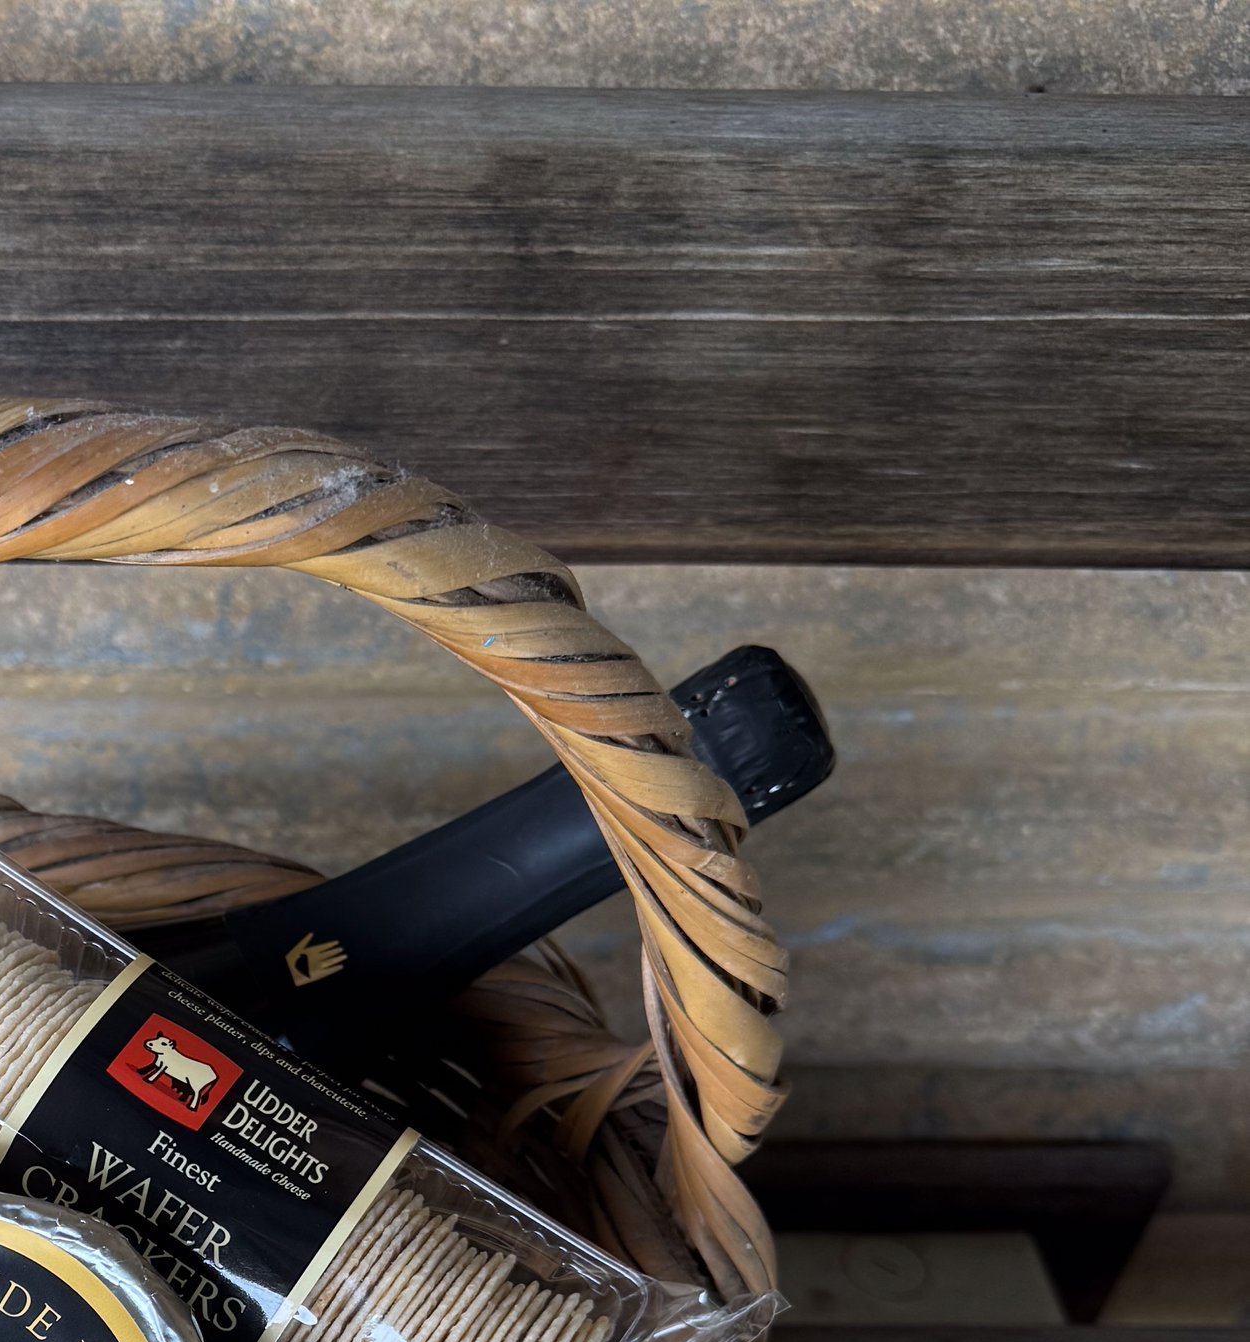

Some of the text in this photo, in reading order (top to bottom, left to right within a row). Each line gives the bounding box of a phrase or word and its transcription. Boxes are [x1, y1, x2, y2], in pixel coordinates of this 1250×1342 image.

[167, 990, 369, 1121] cheese platter, dips and charcuterie.
[221, 1102, 330, 1184] DELIGHTS
[243, 1078, 318, 1144] UDDER
[147, 1131, 222, 1193] Finest
[209, 1132, 272, 1176] Handmade
[87, 1141, 232, 1269] WAFER
[21, 1165, 247, 1332] CRCKERS
